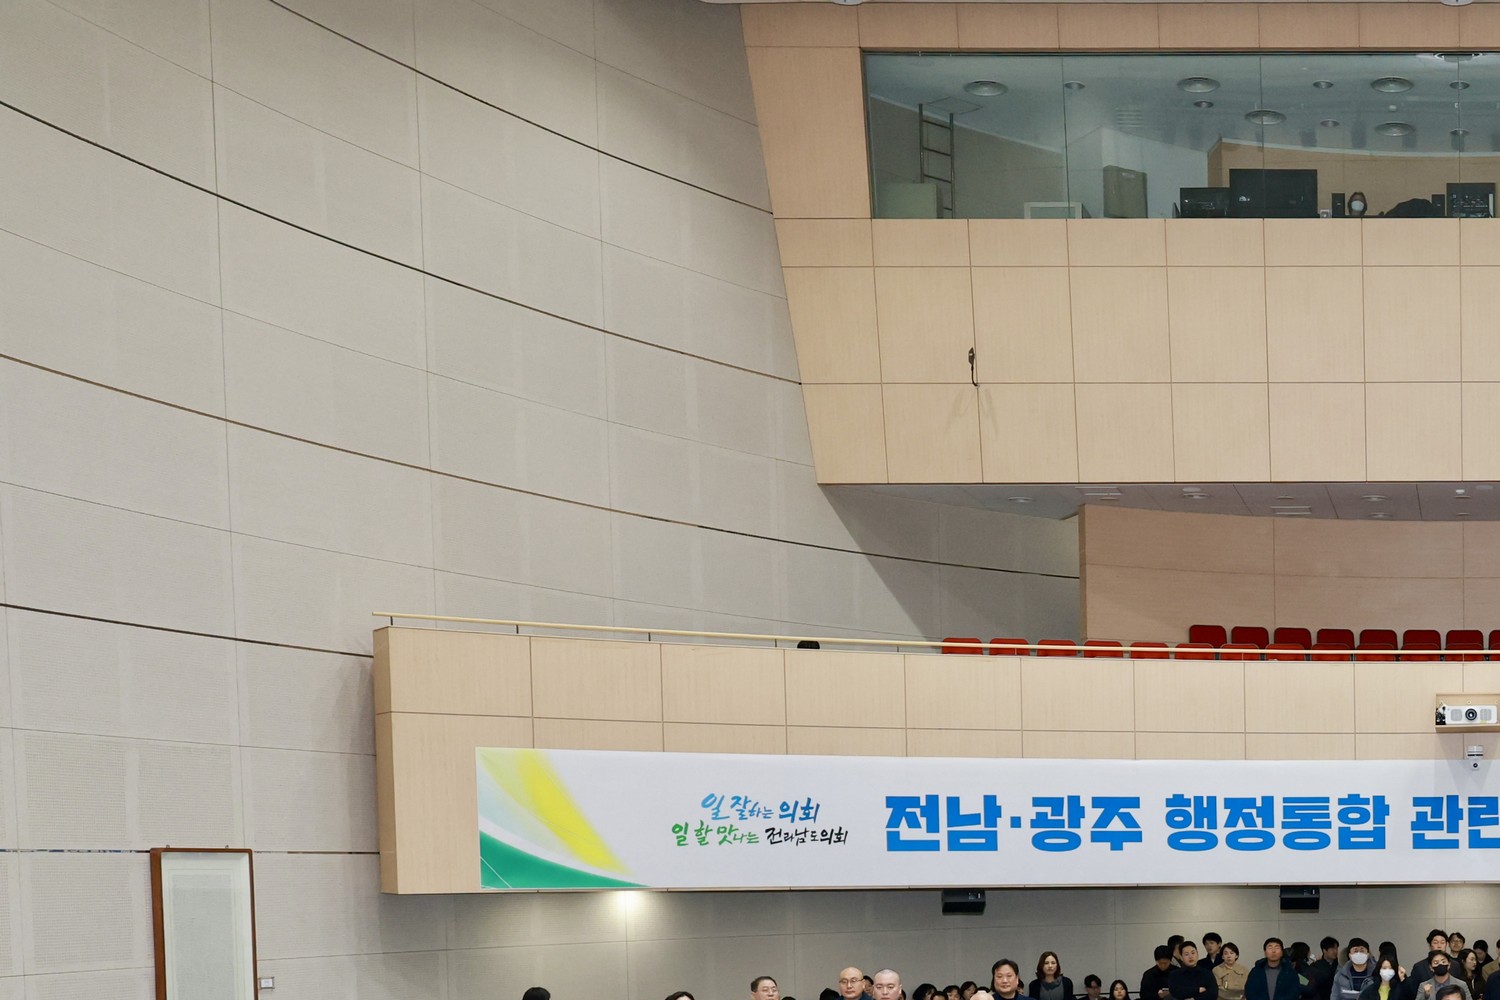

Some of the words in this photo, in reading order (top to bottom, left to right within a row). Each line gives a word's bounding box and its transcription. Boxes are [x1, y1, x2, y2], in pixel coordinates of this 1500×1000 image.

[730, 795, 774, 820] 잘하는
[778, 797, 820, 823] 의회
[885, 793, 1144, 852] 전남·광주
[1165, 793, 1391, 852] 행정통합
[764, 826, 849, 847] 전라남도의회
